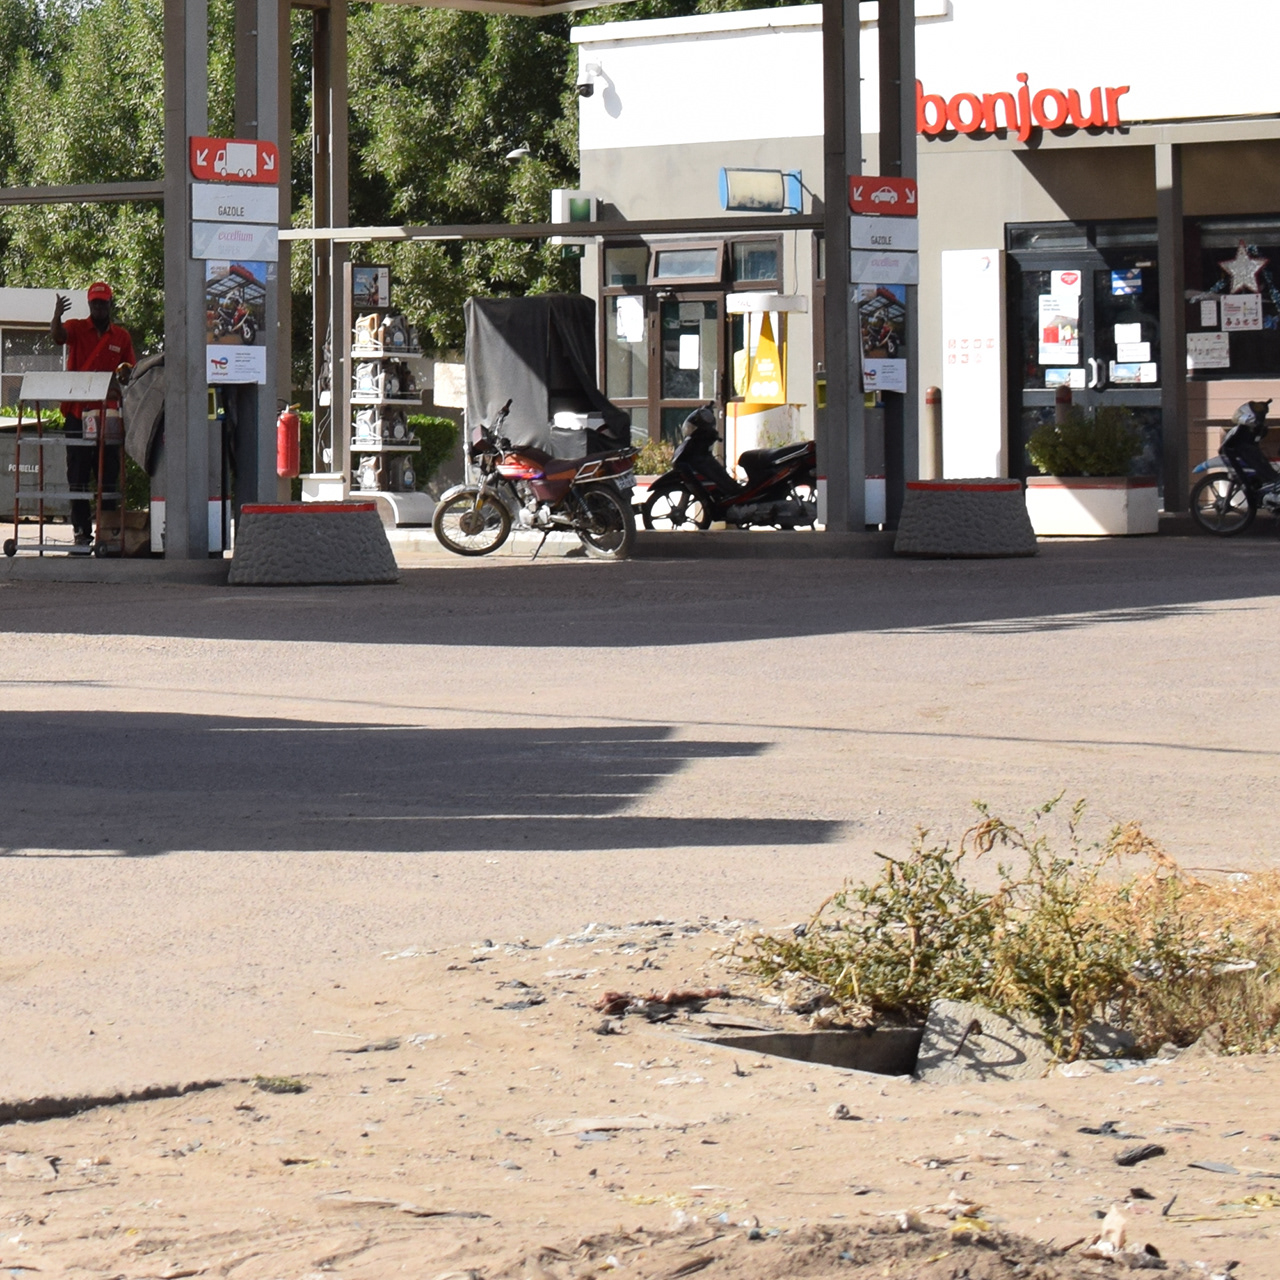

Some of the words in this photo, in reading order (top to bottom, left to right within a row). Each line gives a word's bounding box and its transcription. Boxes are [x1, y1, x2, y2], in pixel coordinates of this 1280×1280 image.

[915, 72, 1130, 142] bonjour
[218, 206, 245, 217] GAZOLE
[870, 235, 892, 245] GAZOLE
[8, 464, 39, 473] POBELLE
